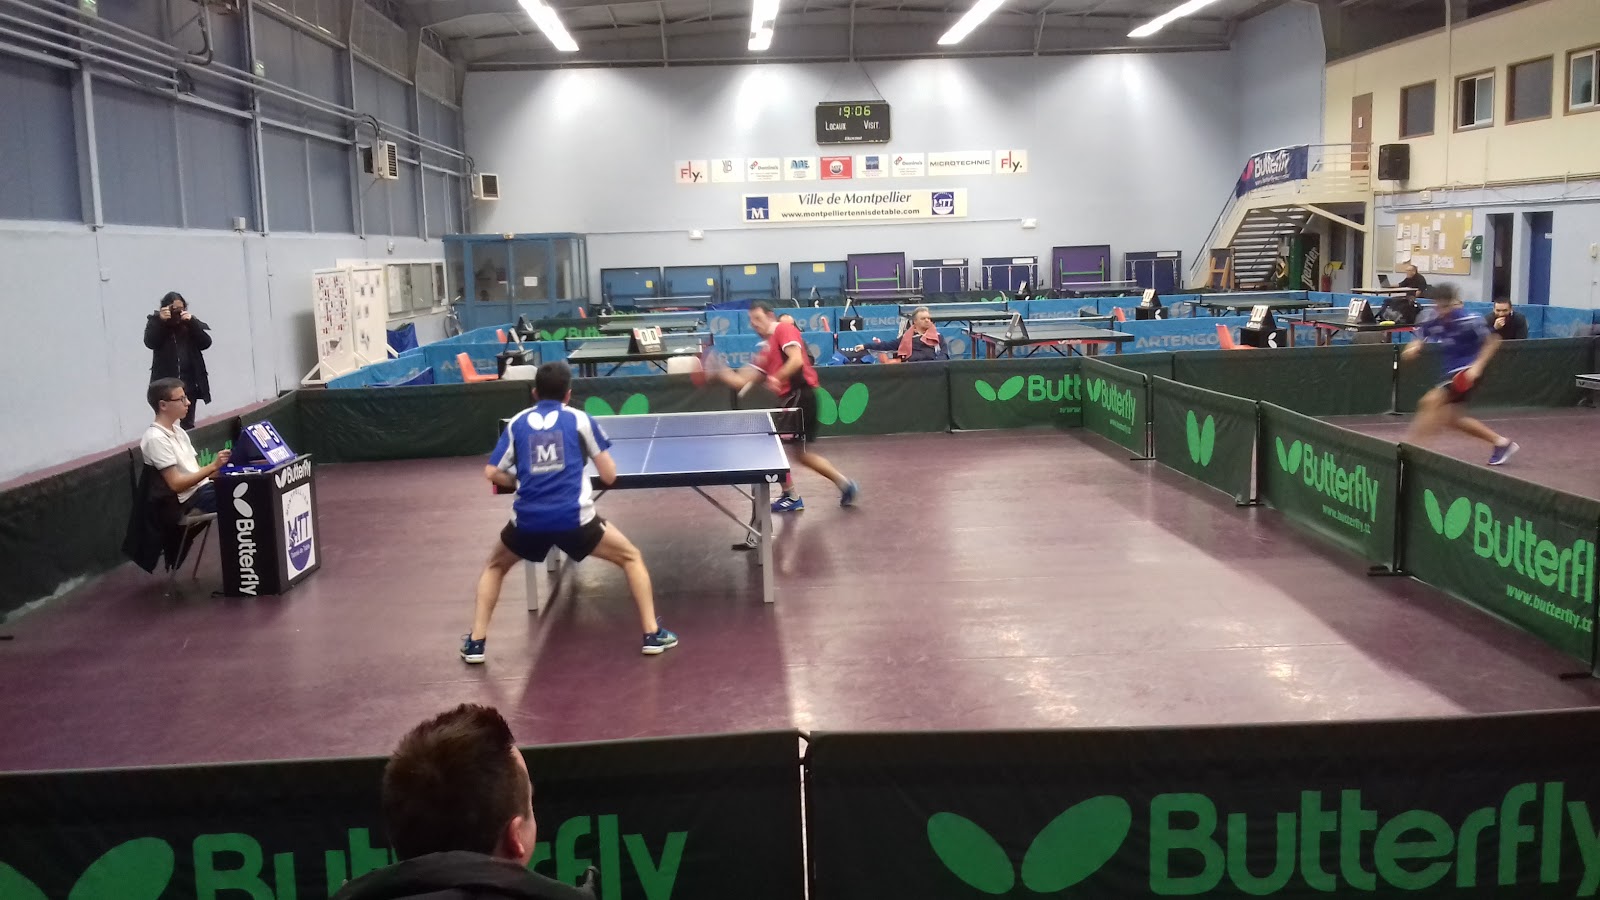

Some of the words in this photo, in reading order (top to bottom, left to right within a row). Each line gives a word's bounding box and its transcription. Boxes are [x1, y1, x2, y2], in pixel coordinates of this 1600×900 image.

[839, 106, 871, 118] 19:06
[680, 161, 703, 183] Fly.
[929, 159, 991, 168] MICROTECHNIC
[1000, 151, 1022, 173] Fly.
[1254, 150, 1290, 179] Butterfly
[798, 195, 824, 206] Ville
[826, 194, 842, 205] de
[844, 191, 912, 206] Montpellier
[750, 208, 766, 219] M
[781, 208, 920, 219] www.montpelliertennisdetable.com
[1135, 335, 1218, 349] ARTENGO
[1101, 379, 1136, 425] Butterfly
[536, 443, 558, 462] M
[286, 459, 311, 485] Butterfly
[1303, 443, 1378, 523] Butterfly
[235, 518, 259, 596] Butterfly
[1473, 502, 1596, 604] Butterfl
